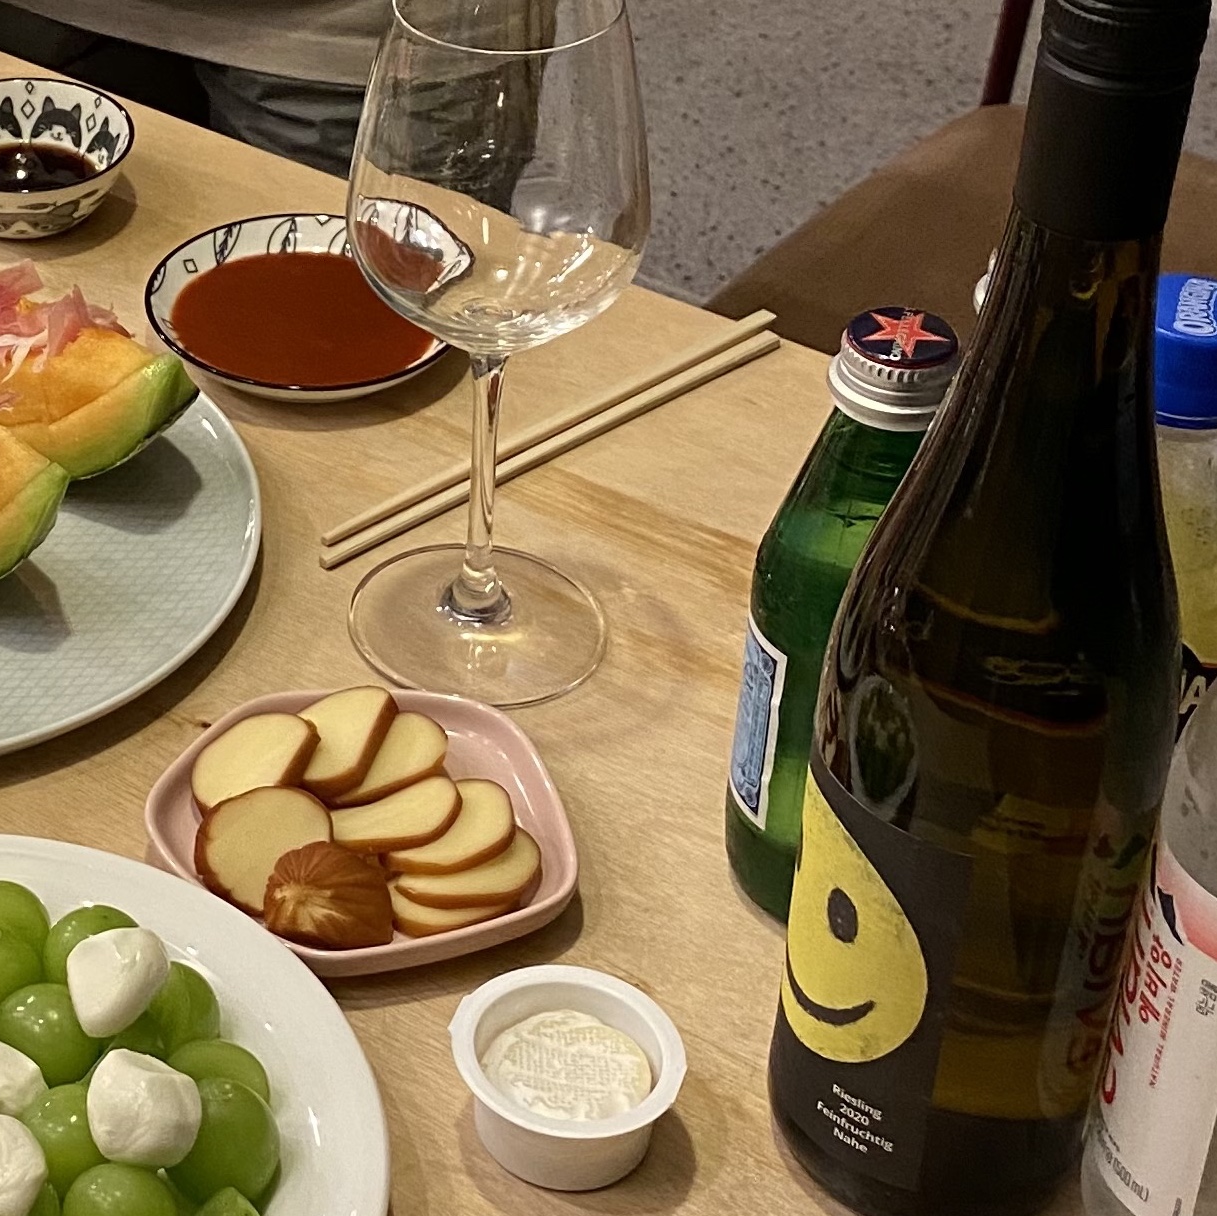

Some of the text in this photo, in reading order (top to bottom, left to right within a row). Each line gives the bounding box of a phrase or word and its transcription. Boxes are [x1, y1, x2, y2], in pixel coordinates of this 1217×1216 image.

[1138, 933, 1172, 1024] 에비앙
[1149, 958, 1183, 1089] NATURAL MINERAL WATER
[832, 1083, 883, 1121] Riesling
[840, 1102, 870, 1127] 2020
[816, 1100, 894, 1153] Feinfruchtig
[833, 1127, 868, 1154] Nahe
